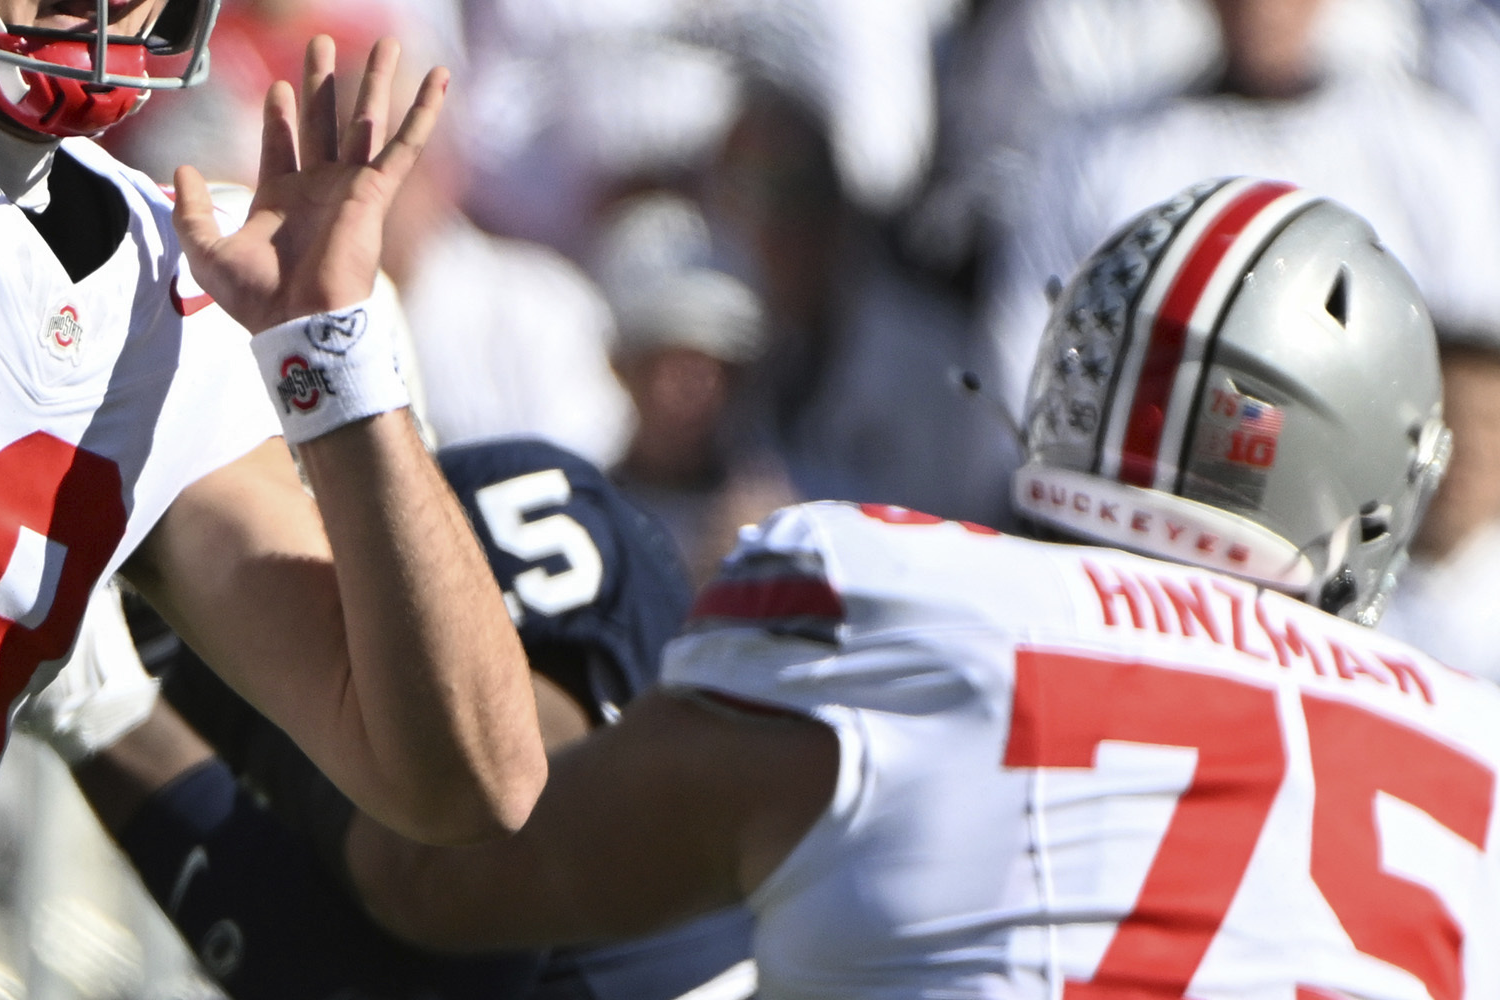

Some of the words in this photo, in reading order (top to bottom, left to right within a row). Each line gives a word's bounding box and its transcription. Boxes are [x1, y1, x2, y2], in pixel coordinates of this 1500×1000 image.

[1027, 478, 1251, 563] BUCKEYES
[1225, 430, 1278, 468] 10
[475, 467, 604, 626] 5
[1081, 558, 1435, 705] HINZMAN
[1002, 645, 1497, 1000] 75
